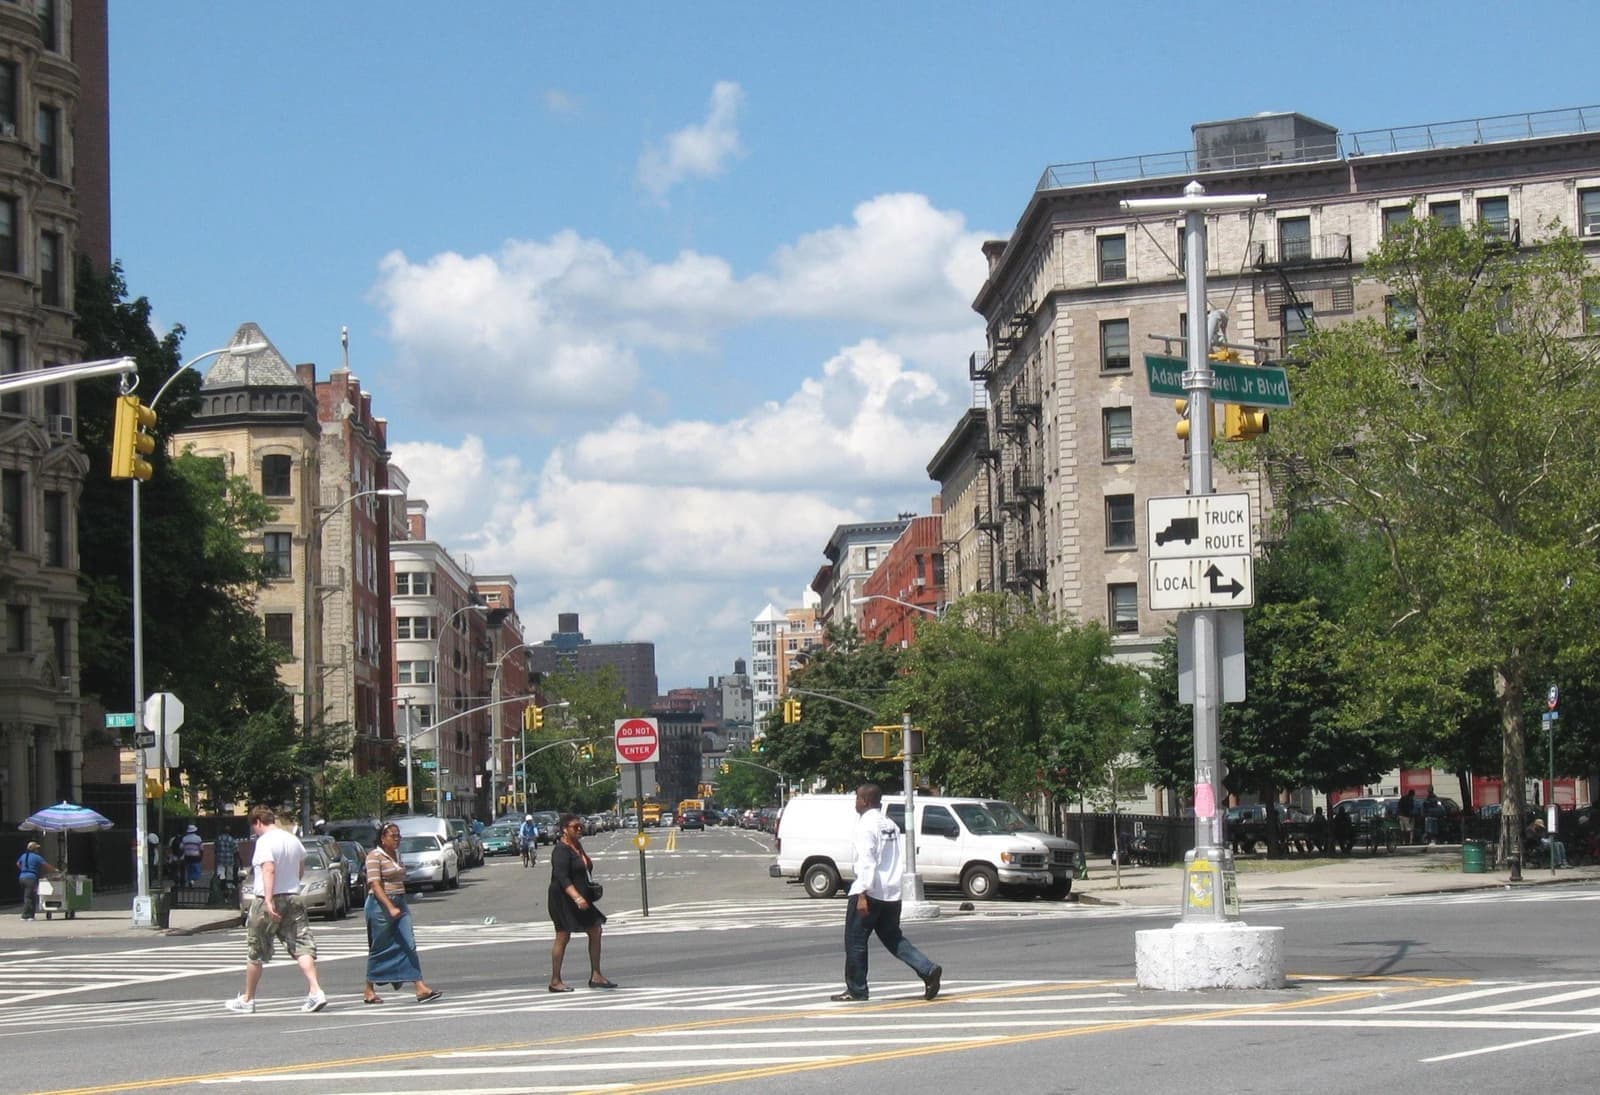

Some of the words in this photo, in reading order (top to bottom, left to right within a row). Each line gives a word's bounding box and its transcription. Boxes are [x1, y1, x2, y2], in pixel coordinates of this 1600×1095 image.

[1215, 375, 1238, 393] well
[1241, 376, 1254, 394] Jr
[1257, 377, 1286, 396] Blvd
[1205, 510, 1244, 525] TRUCK
[1205, 534, 1245, 549] ROUTE
[1156, 576, 1197, 591] LOCAL
[622, 728, 633, 736] DO
[635, 727, 650, 735] NOT
[624, 746, 650, 755] ENTER
